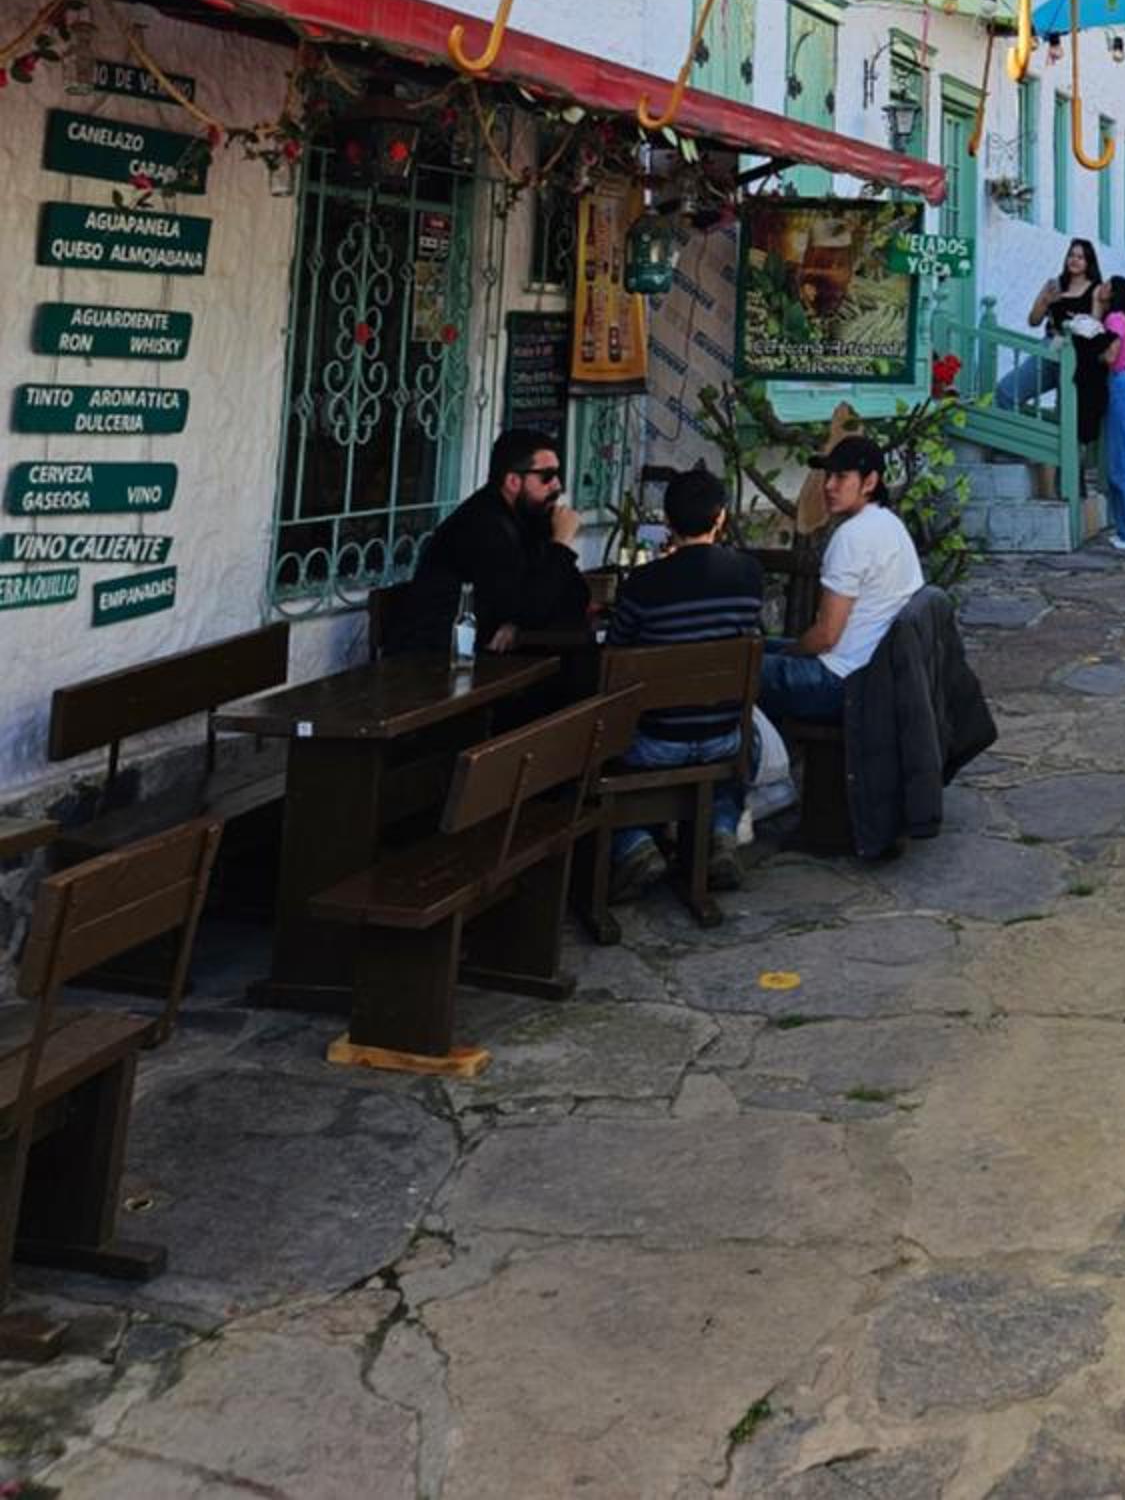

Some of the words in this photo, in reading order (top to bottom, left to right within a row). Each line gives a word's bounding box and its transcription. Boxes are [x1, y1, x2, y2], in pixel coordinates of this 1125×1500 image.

[114, 68, 136, 91] DE
[67, 122, 145, 152] CANELAZO
[84, 211, 181, 238] AGUAPANELA
[51, 239, 104, 260] QUESO
[110, 244, 203, 268] ALMOJABANA
[70, 308, 170, 331] AGUARDIENTE
[59, 332, 93, 351] RON
[129, 336, 183, 356] WHISKY
[26, 387, 74, 407] TINTO
[88, 389, 180, 410] AROMATICA
[75, 413, 144, 432] DULCERIA
[29, 465, 93, 484] CERVEZA
[22, 490, 91, 512] GASEOSA
[127, 485, 162, 505] VINO
[13, 535, 66, 560] VINO
[69, 535, 163, 562] CALIENTE
[100, 577, 175, 612] EMPANADAS
